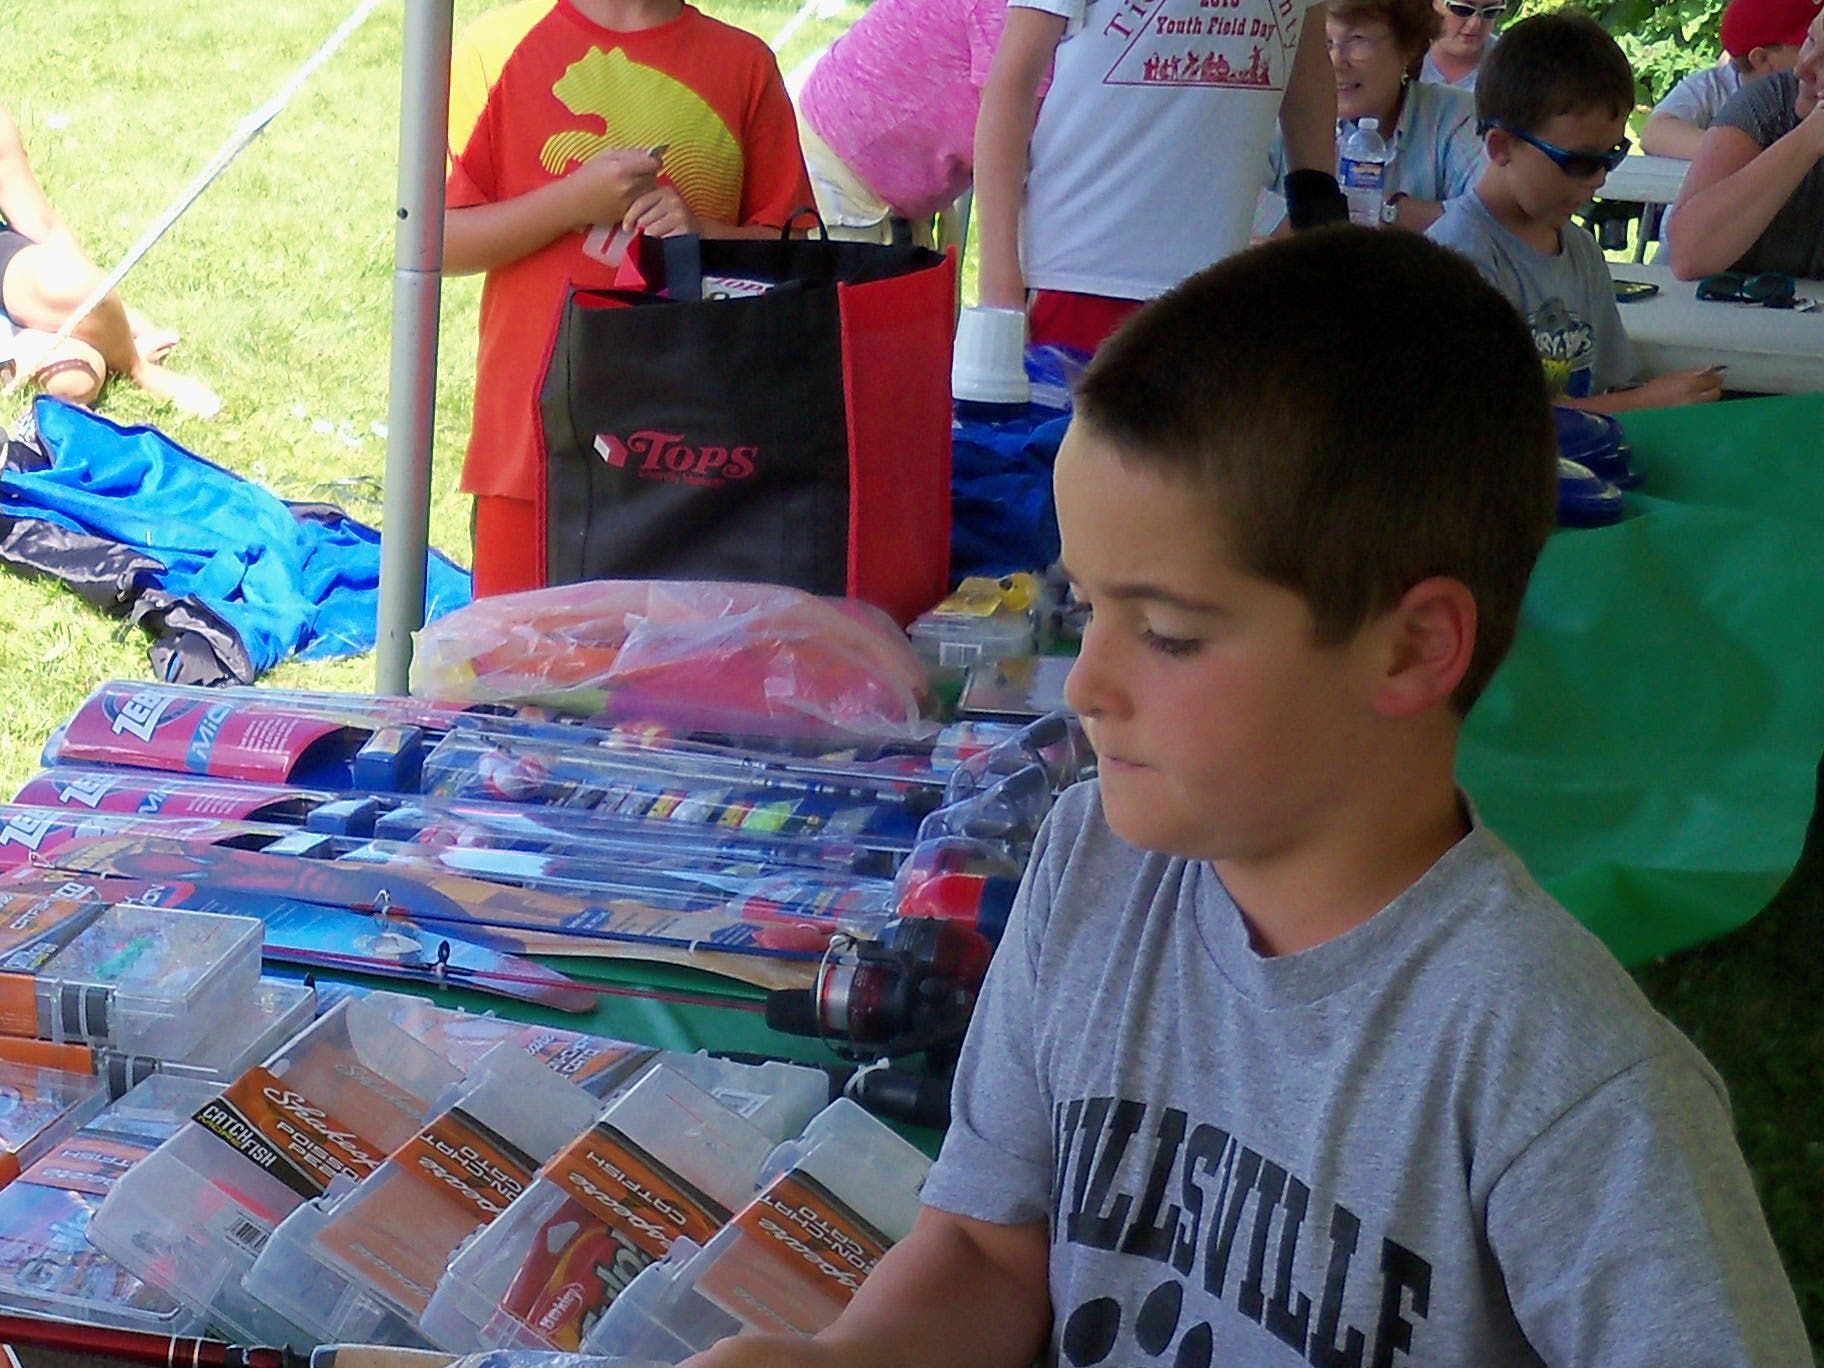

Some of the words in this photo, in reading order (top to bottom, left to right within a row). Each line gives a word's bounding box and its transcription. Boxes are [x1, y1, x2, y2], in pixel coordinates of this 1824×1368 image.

[1156, 15, 1202, 36] Youth
[1207, 16, 1246, 37] Field
[1250, 18, 1276, 42] Day
[203, 1104, 250, 1148] CATCH
[240, 1137, 279, 1168] FISH
[586, 1151, 688, 1227] CATFISH
